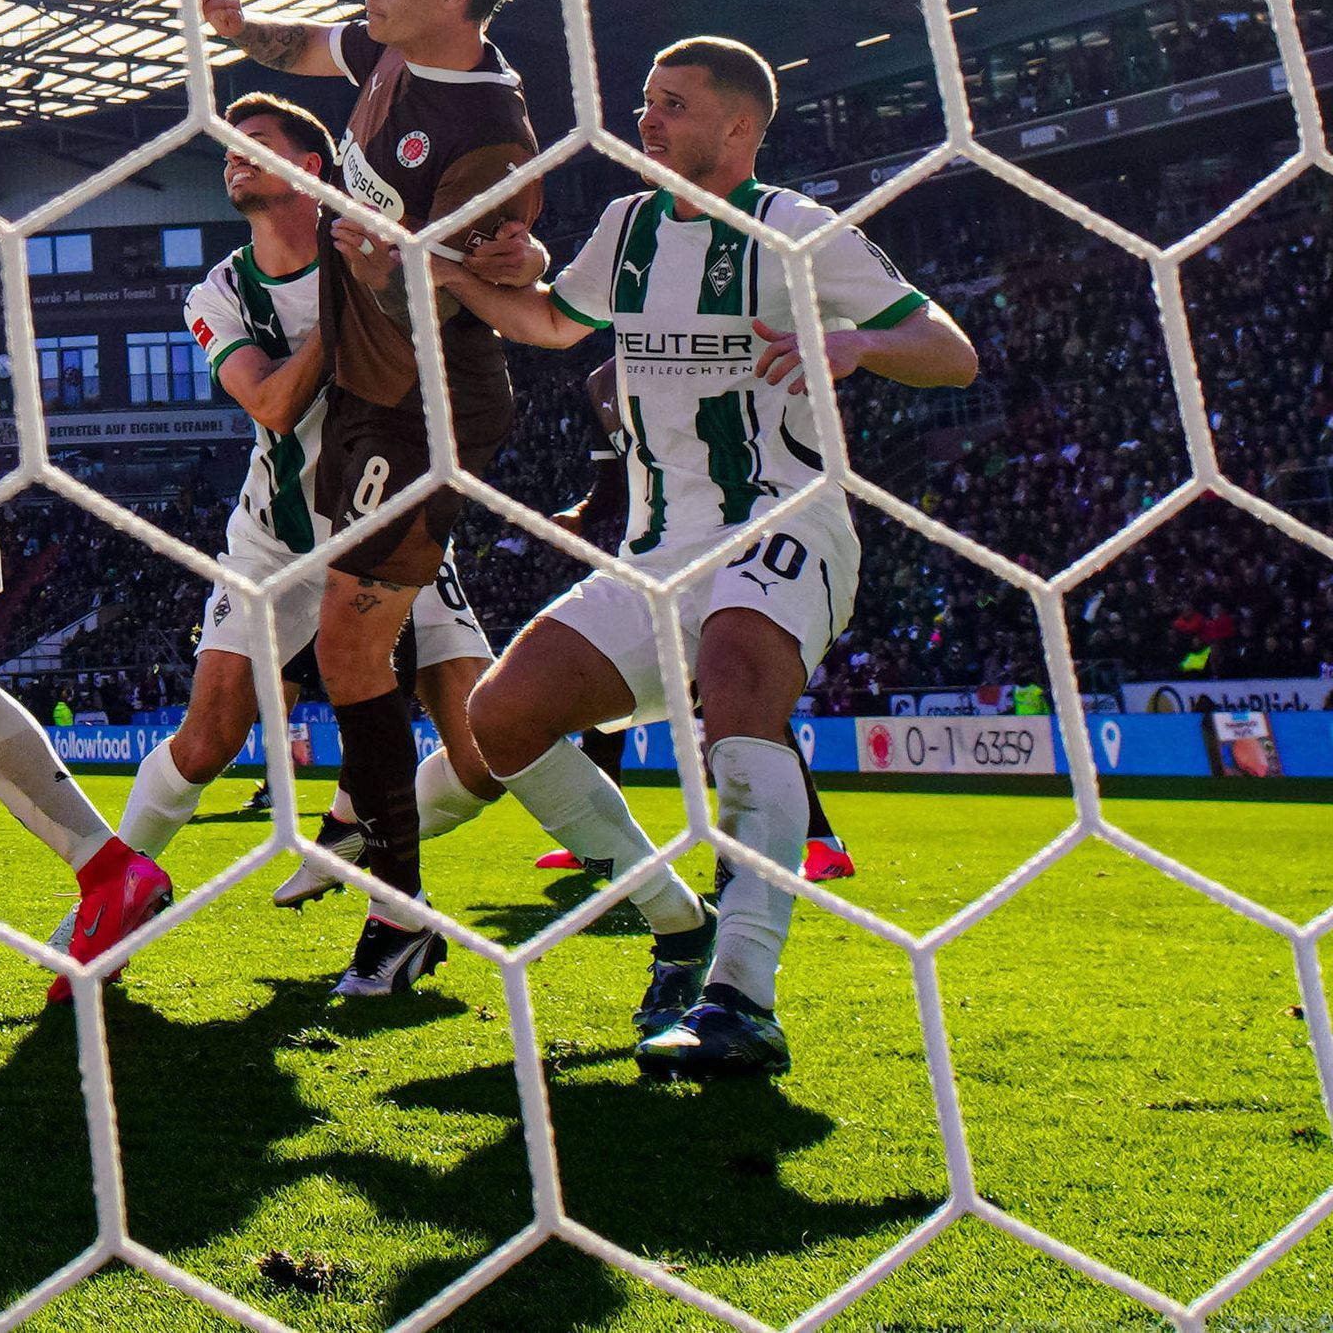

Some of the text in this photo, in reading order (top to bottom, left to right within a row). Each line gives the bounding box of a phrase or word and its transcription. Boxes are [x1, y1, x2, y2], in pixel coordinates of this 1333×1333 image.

[658, 366, 753, 375] LEUCHTEN
[49, 418, 223, 438] BETRETEN AUF EIGENE GEFAHR!
[353, 456, 390, 514] 8
